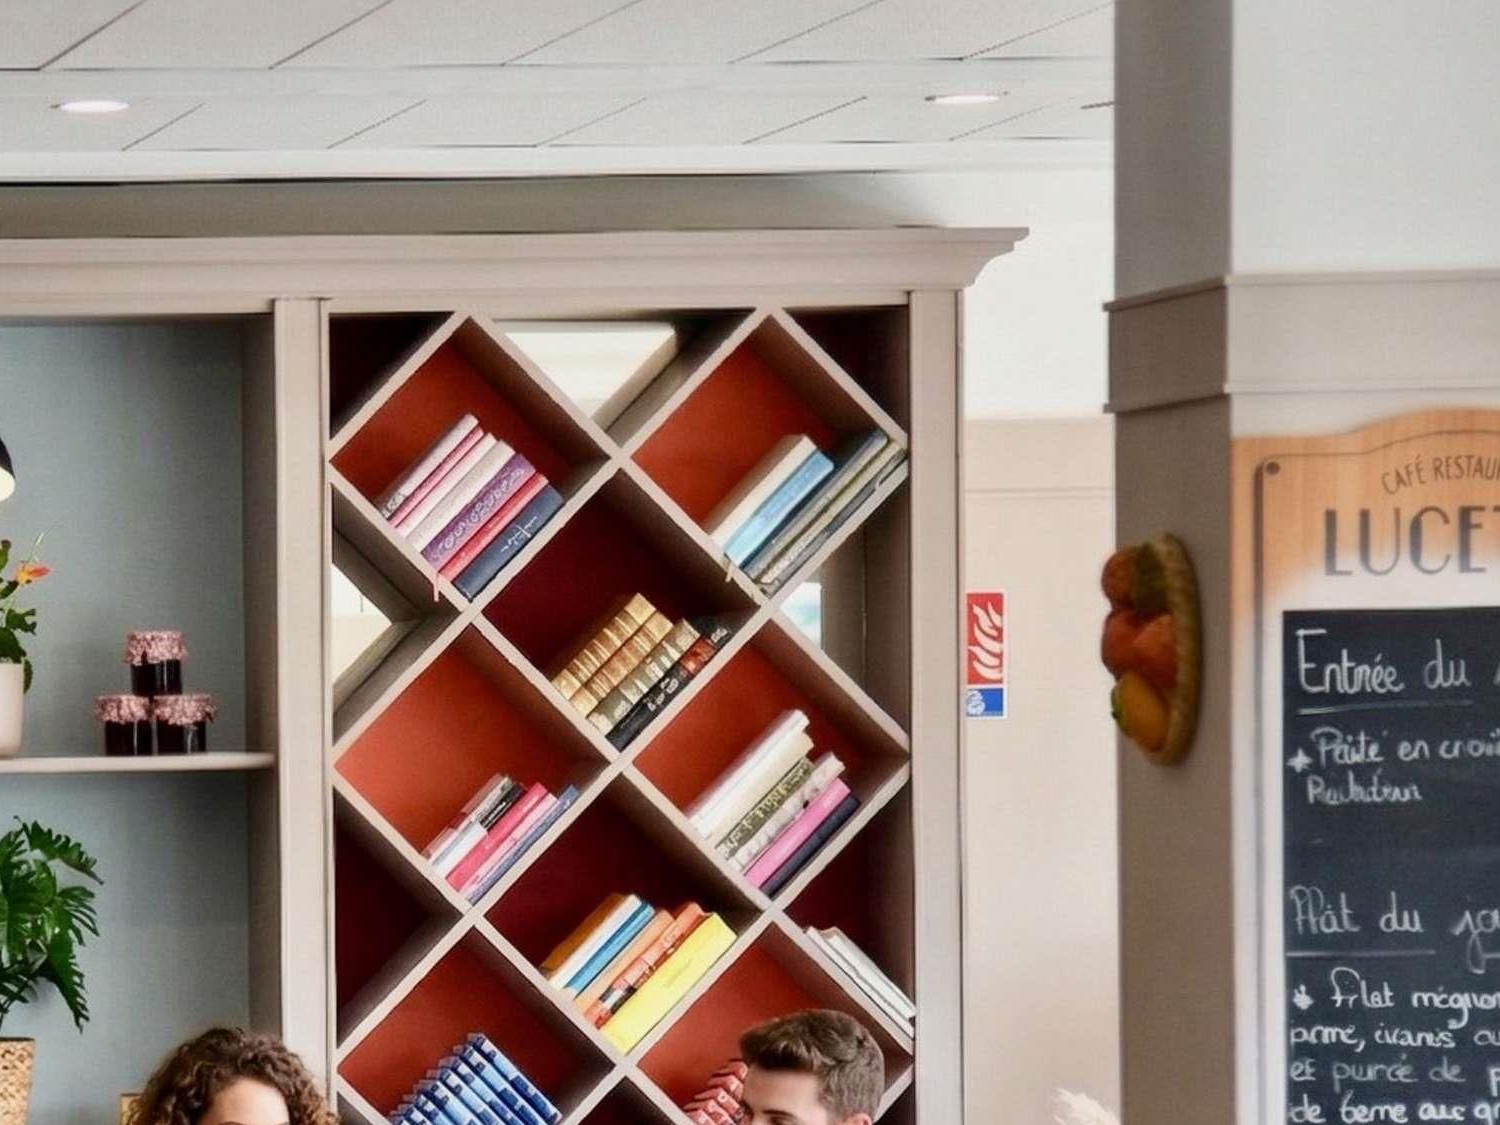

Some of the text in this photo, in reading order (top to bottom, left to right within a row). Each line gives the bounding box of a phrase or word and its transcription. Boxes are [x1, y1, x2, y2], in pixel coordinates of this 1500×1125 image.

[1380, 454, 1500, 495] CAFÉ RESTAU
[1323, 505, 1500, 576] LUCE
[1295, 628, 1405, 694] Entrée
[1423, 638, 1472, 690] du
[1397, 740, 1430, 761] en
[1378, 891, 1424, 933] du
[1427, 1055, 1467, 1083] de
[1287, 1093, 1327, 1124] de
